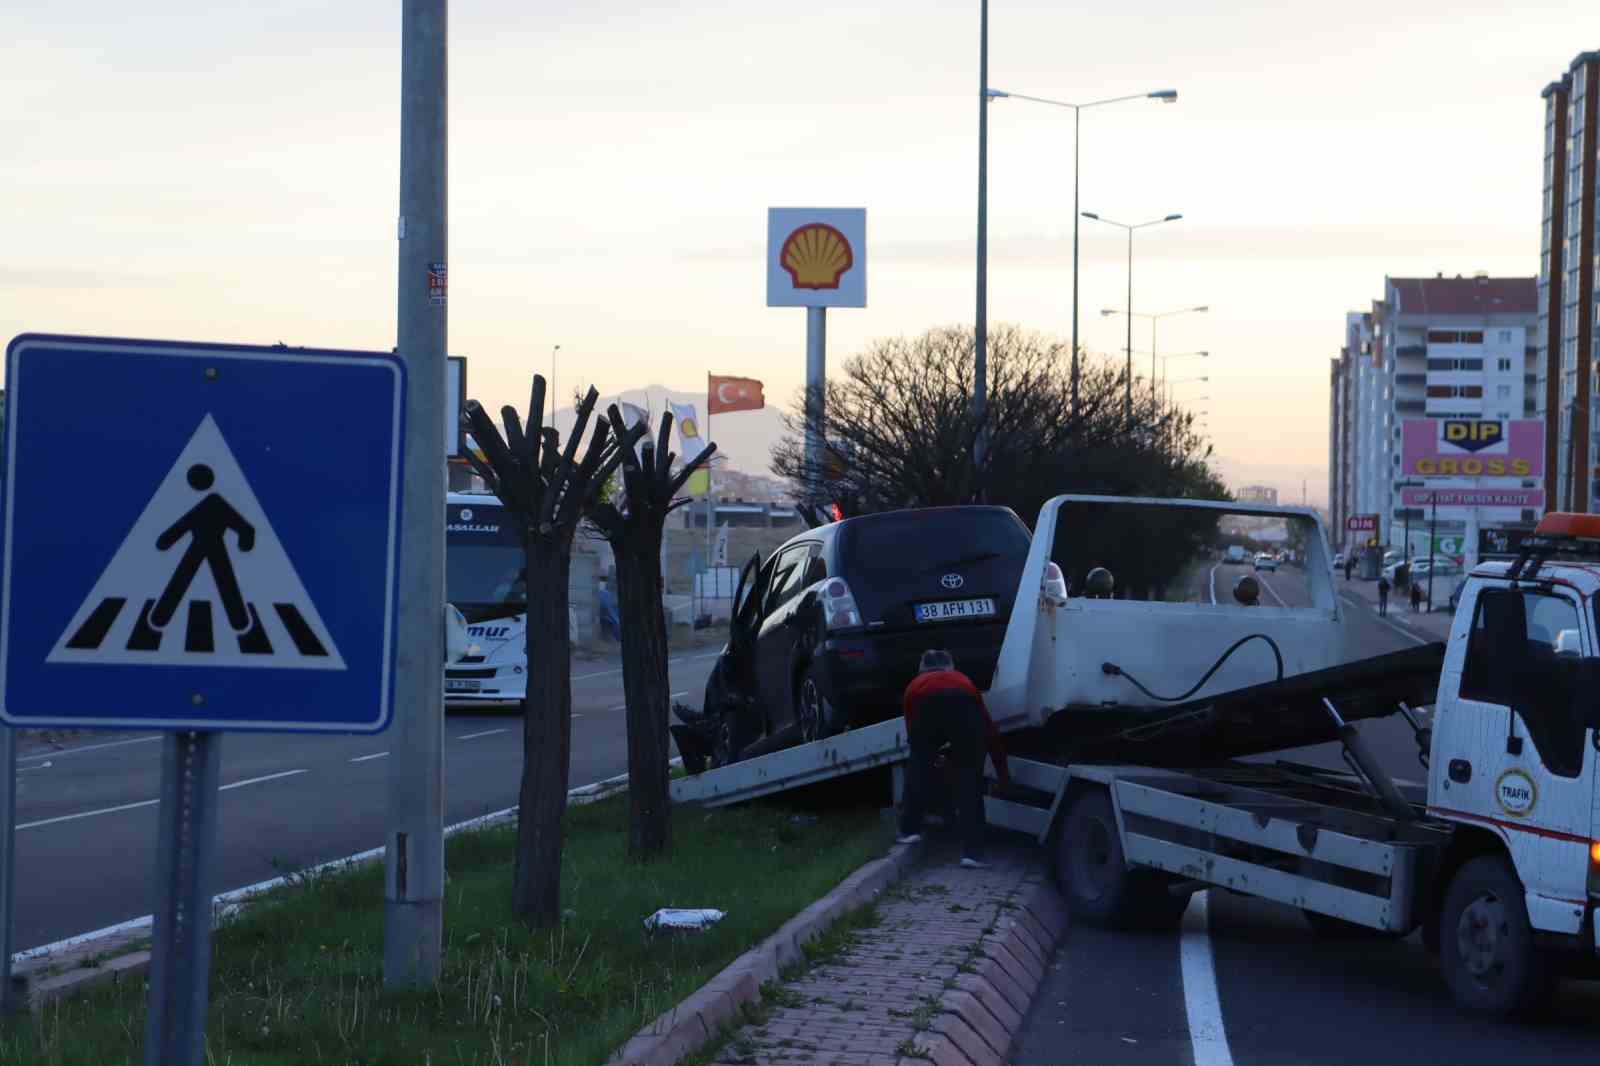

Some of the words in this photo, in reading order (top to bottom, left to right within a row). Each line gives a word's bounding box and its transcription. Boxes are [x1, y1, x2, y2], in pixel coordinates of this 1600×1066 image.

[1415, 457, 1530, 475] GROSS
[446, 523, 500, 533] ASALLAH
[922, 604, 938, 618] 38
[943, 602, 966, 617] AFH
[969, 600, 991, 614] 131
[466, 626, 511, 637] mur
